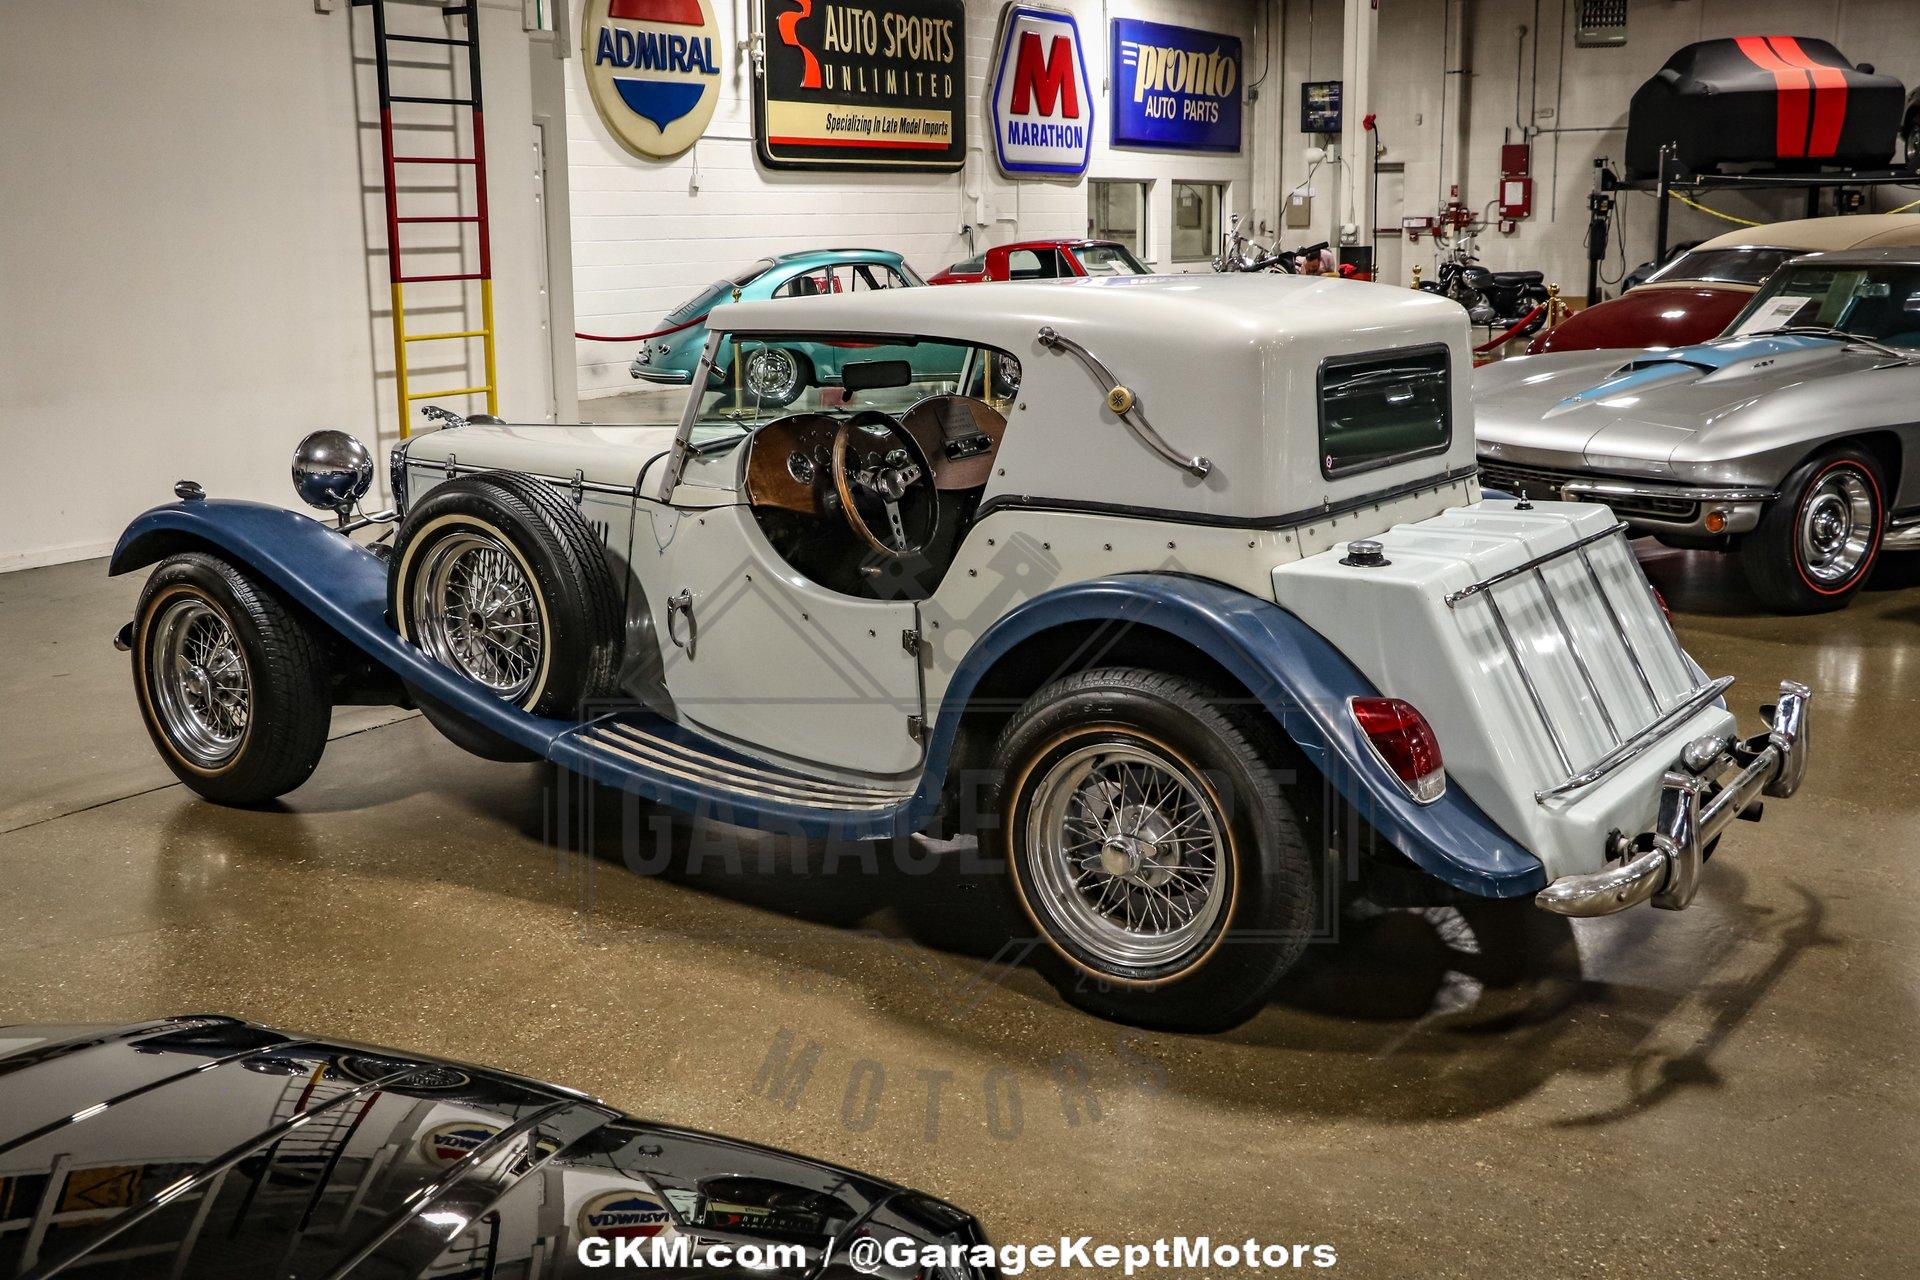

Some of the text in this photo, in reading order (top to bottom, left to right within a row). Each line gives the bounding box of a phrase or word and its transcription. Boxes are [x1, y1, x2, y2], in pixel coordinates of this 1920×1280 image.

[595, 26, 720, 75] ADMIRAL
[824, 4, 954, 64] AUTO SPORTS
[825, 64, 953, 99] UNLIMITED
[1010, 31, 1080, 119] M
[1134, 43, 1237, 103] pronto
[826, 113, 949, 137] Specializing In Late Model Imports
[1145, 95, 1219, 124] AUTO PARTS
[1007, 120, 1083, 149] MARATHON
